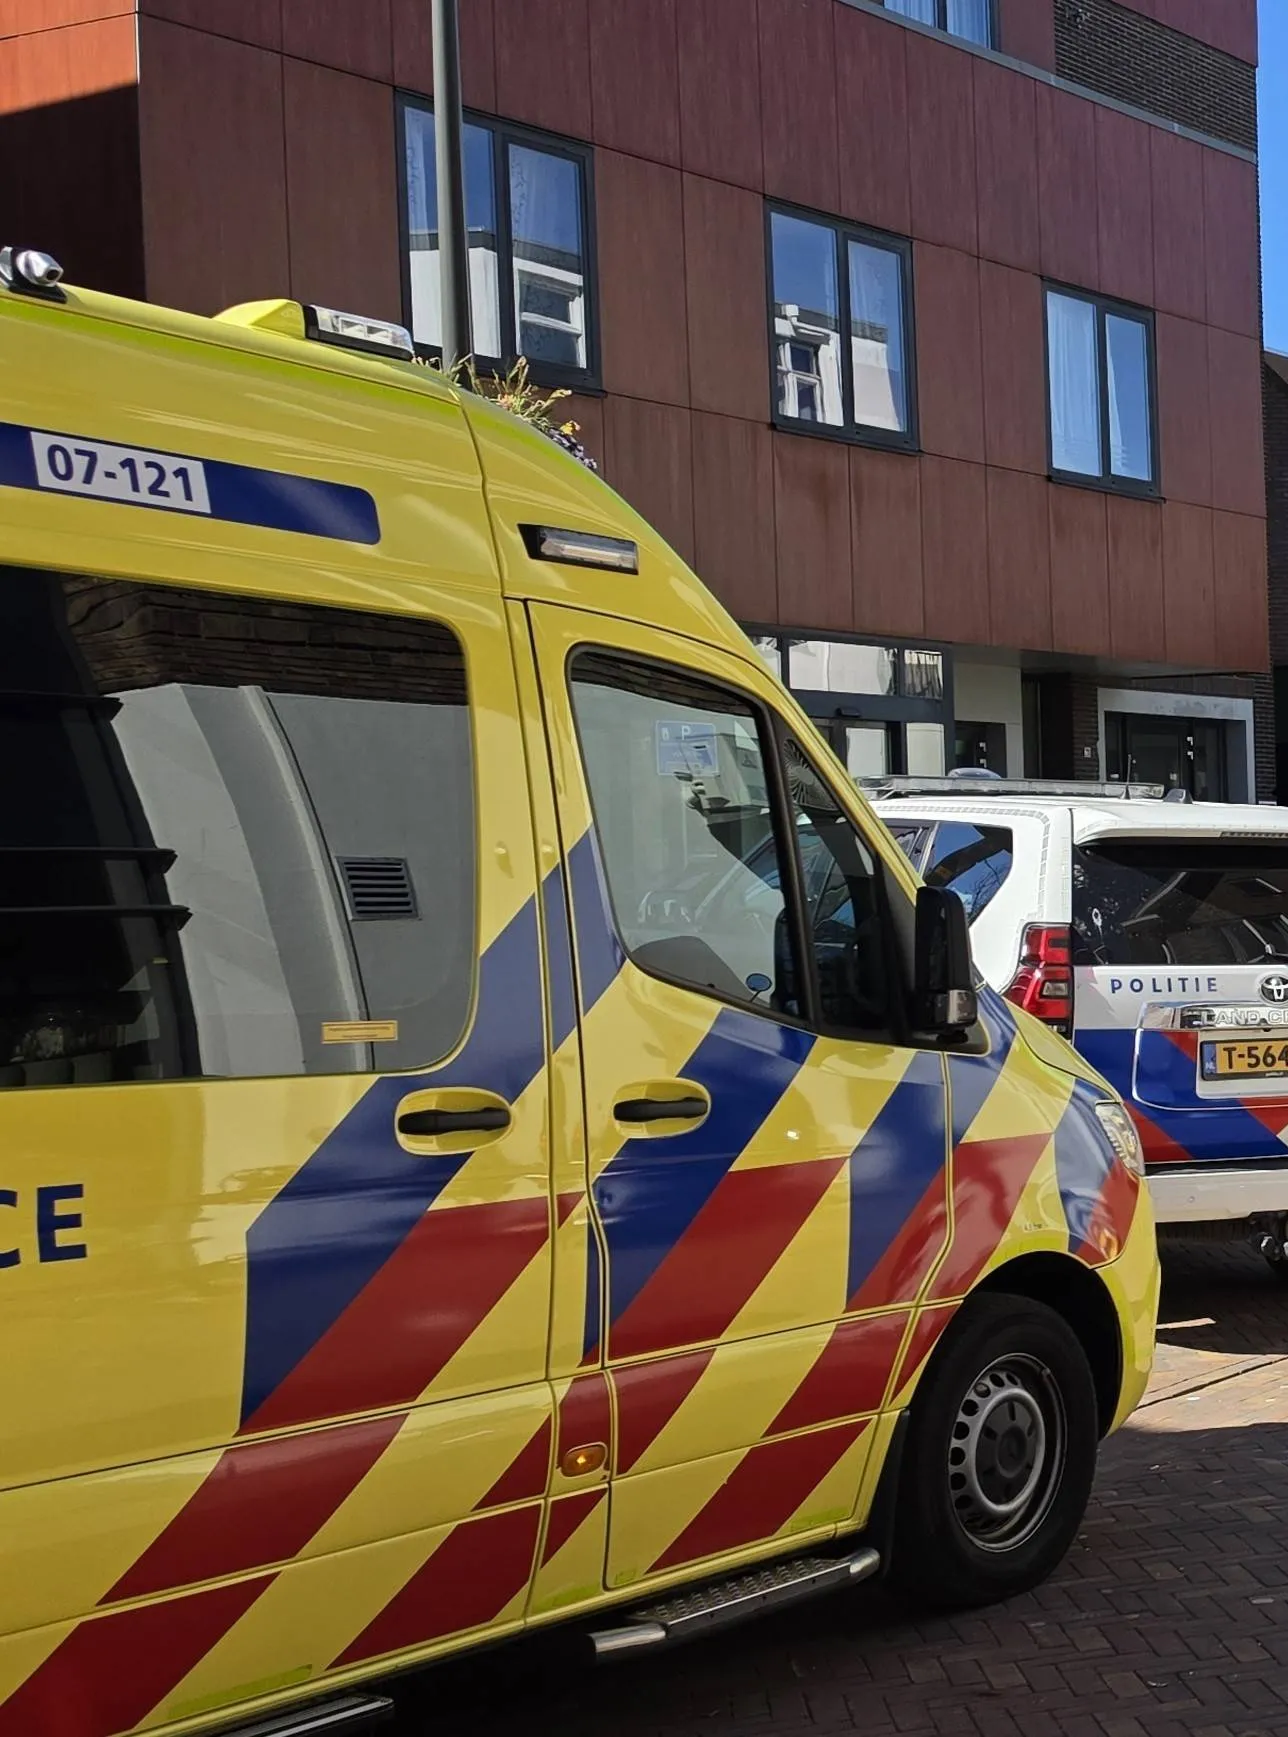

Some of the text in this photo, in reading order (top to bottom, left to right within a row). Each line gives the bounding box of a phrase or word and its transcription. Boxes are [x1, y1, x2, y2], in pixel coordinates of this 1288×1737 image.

[47, 443, 194, 502] 07-121
[1110, 977, 1218, 994] POLITIE
[1200, 1009, 1261, 1026] LAND
